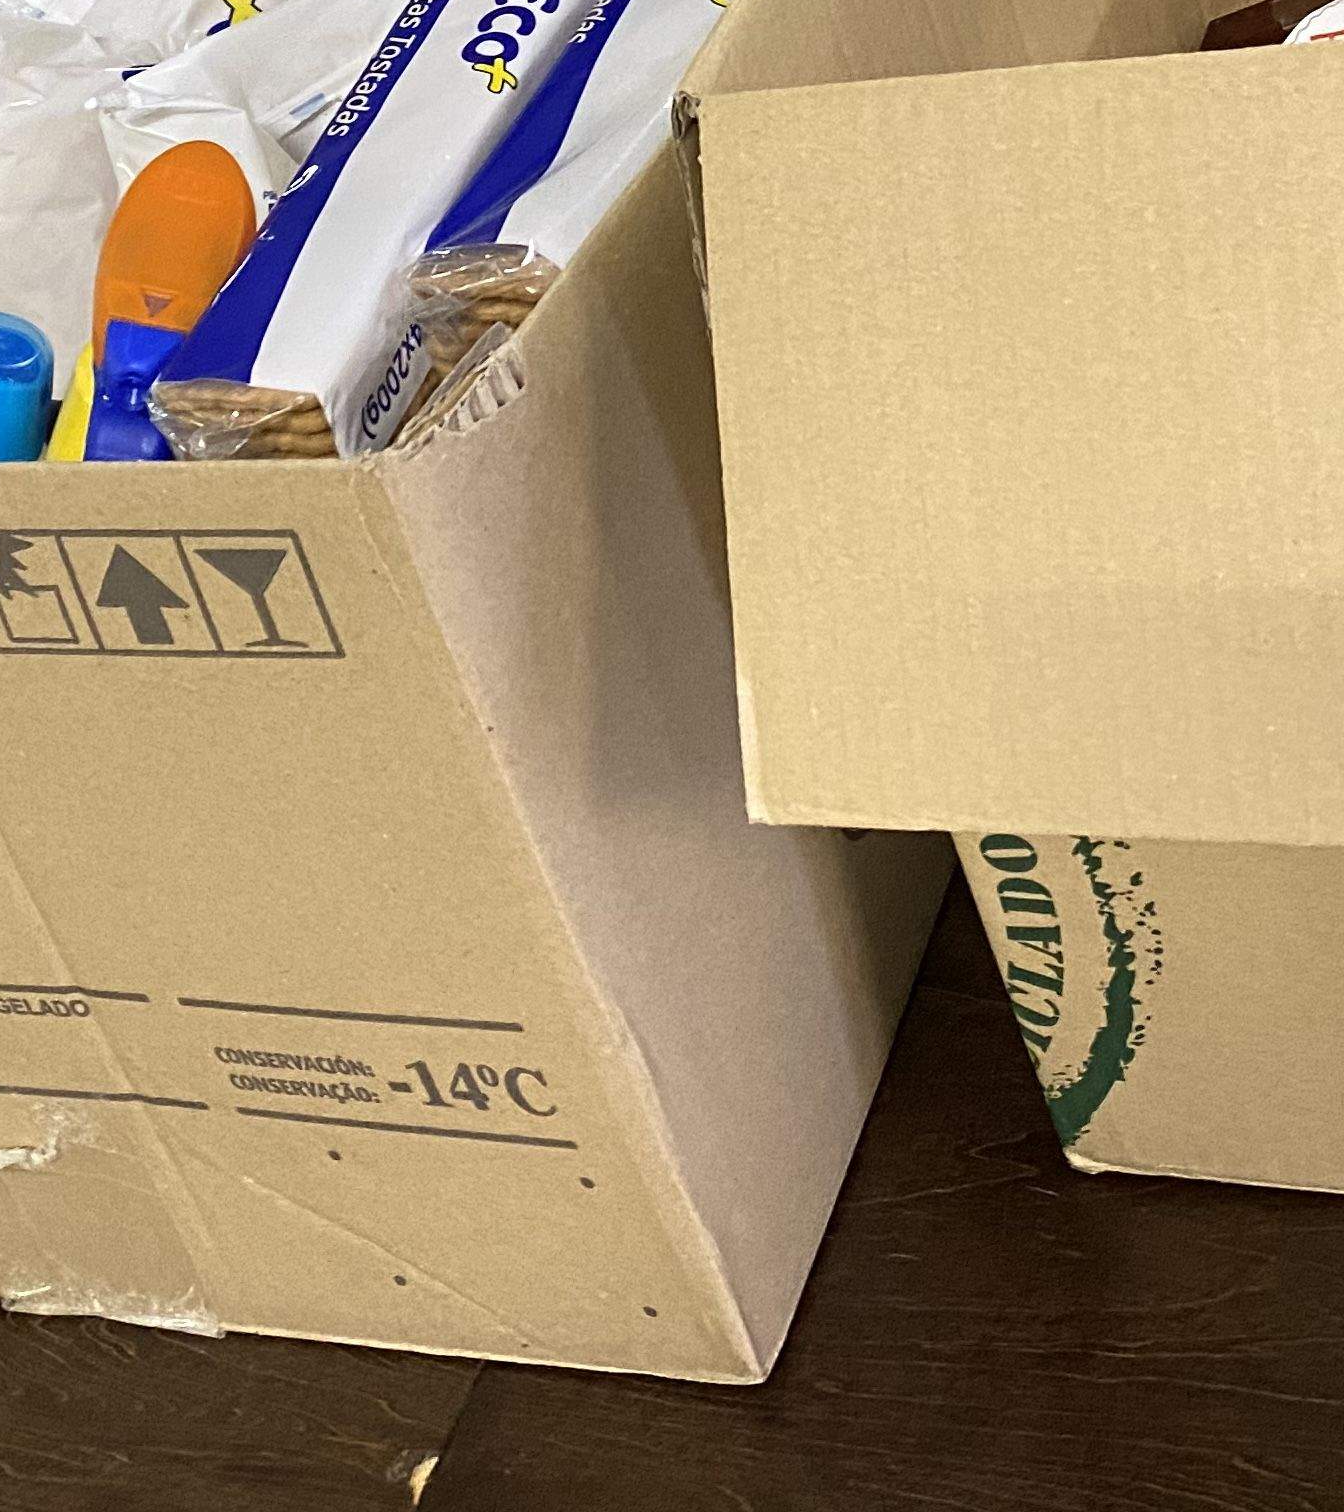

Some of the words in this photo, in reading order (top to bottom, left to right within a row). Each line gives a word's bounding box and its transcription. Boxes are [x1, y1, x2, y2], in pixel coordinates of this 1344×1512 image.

[325, 33, 423, 140] Tostadas
[212, 1046, 378, 1079] CONSERVACIÓN:
[228, 1072, 384, 1105] CONSERVAÇÃO:
